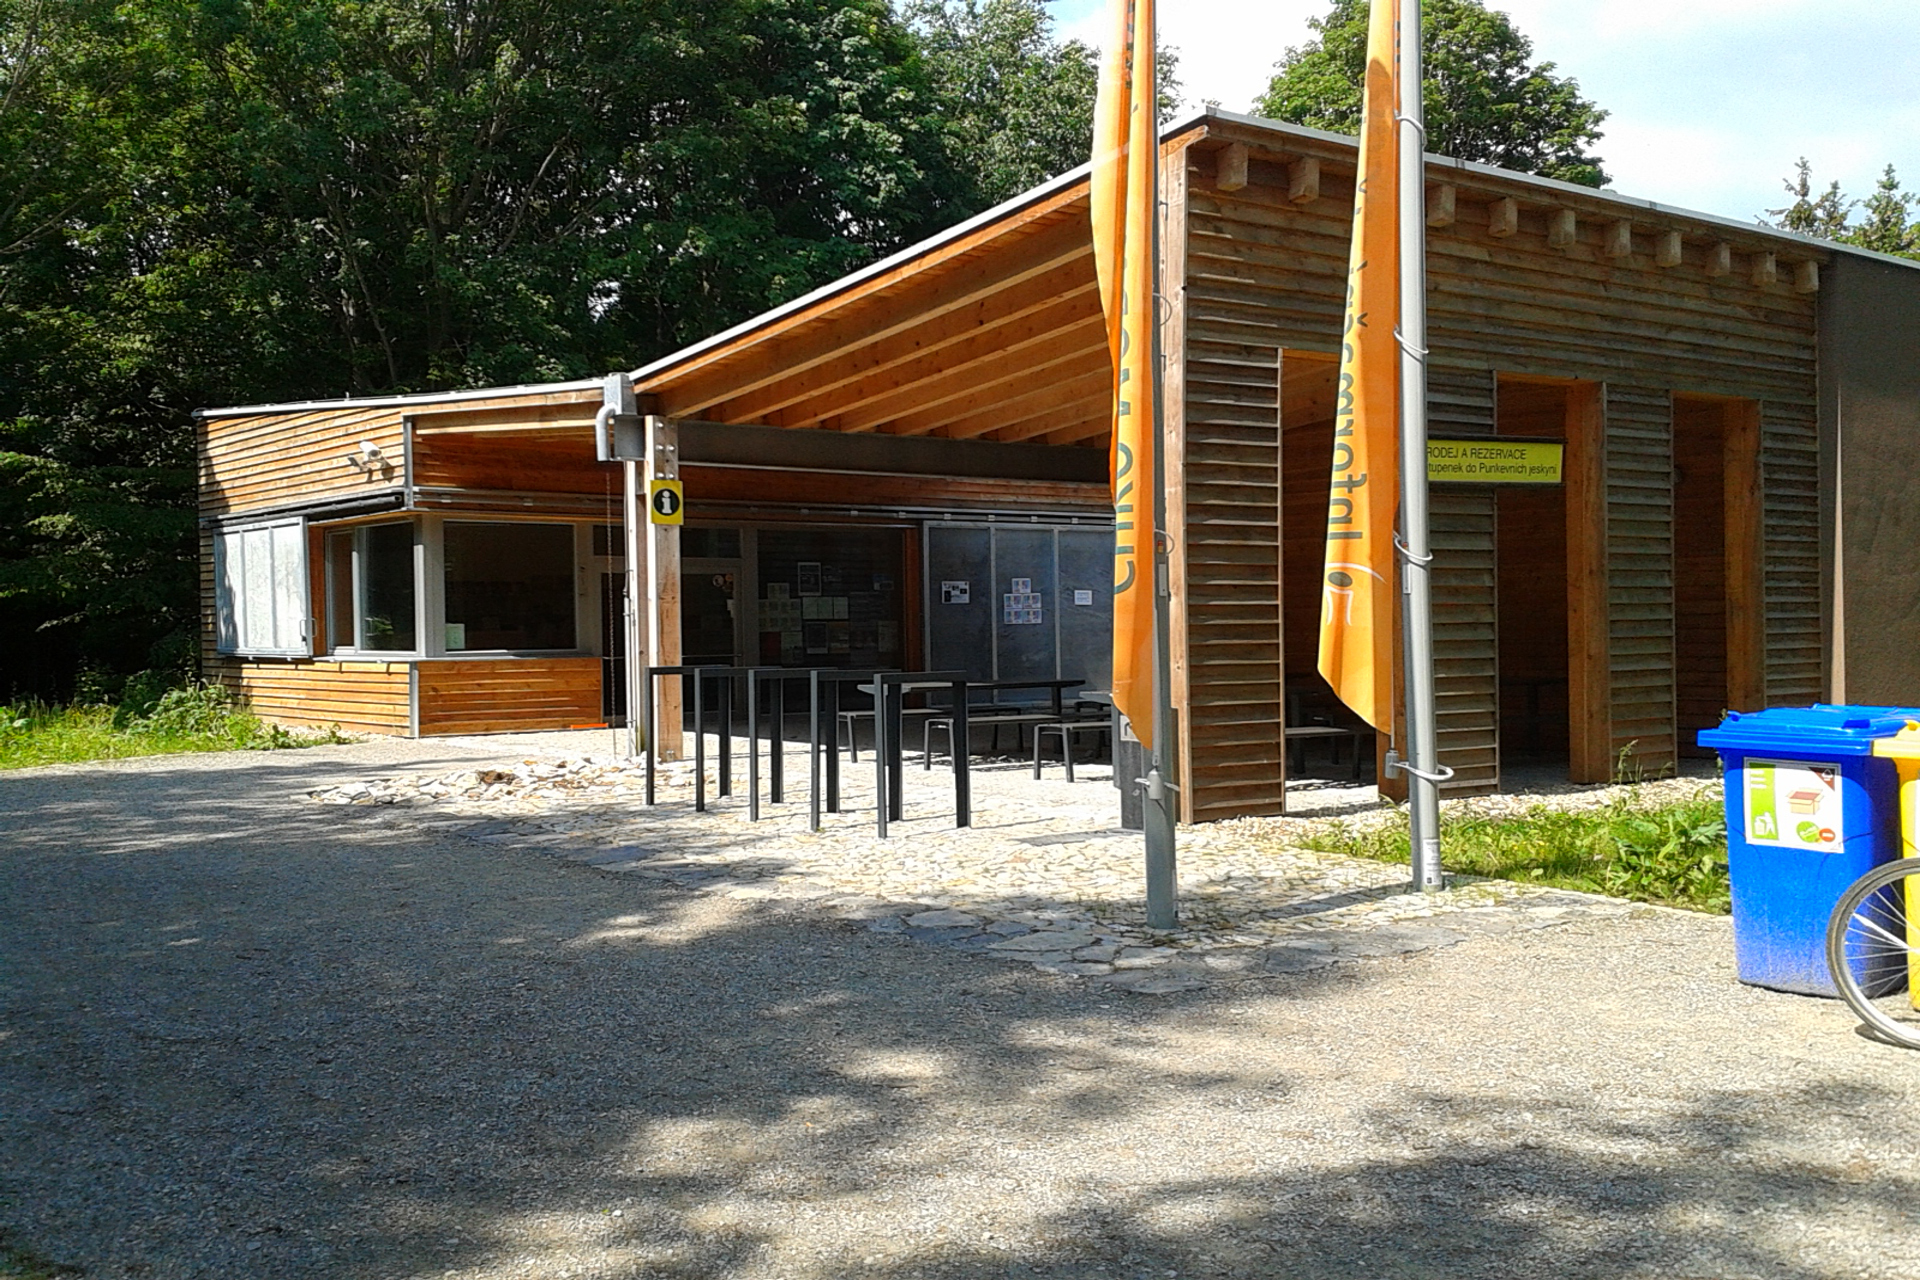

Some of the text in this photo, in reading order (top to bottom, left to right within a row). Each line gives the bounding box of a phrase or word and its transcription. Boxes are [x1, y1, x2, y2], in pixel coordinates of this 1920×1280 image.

[1461, 447, 1468, 459] A
[1470, 447, 1527, 460] REZERVACE
[1465, 463, 1477, 473] do
